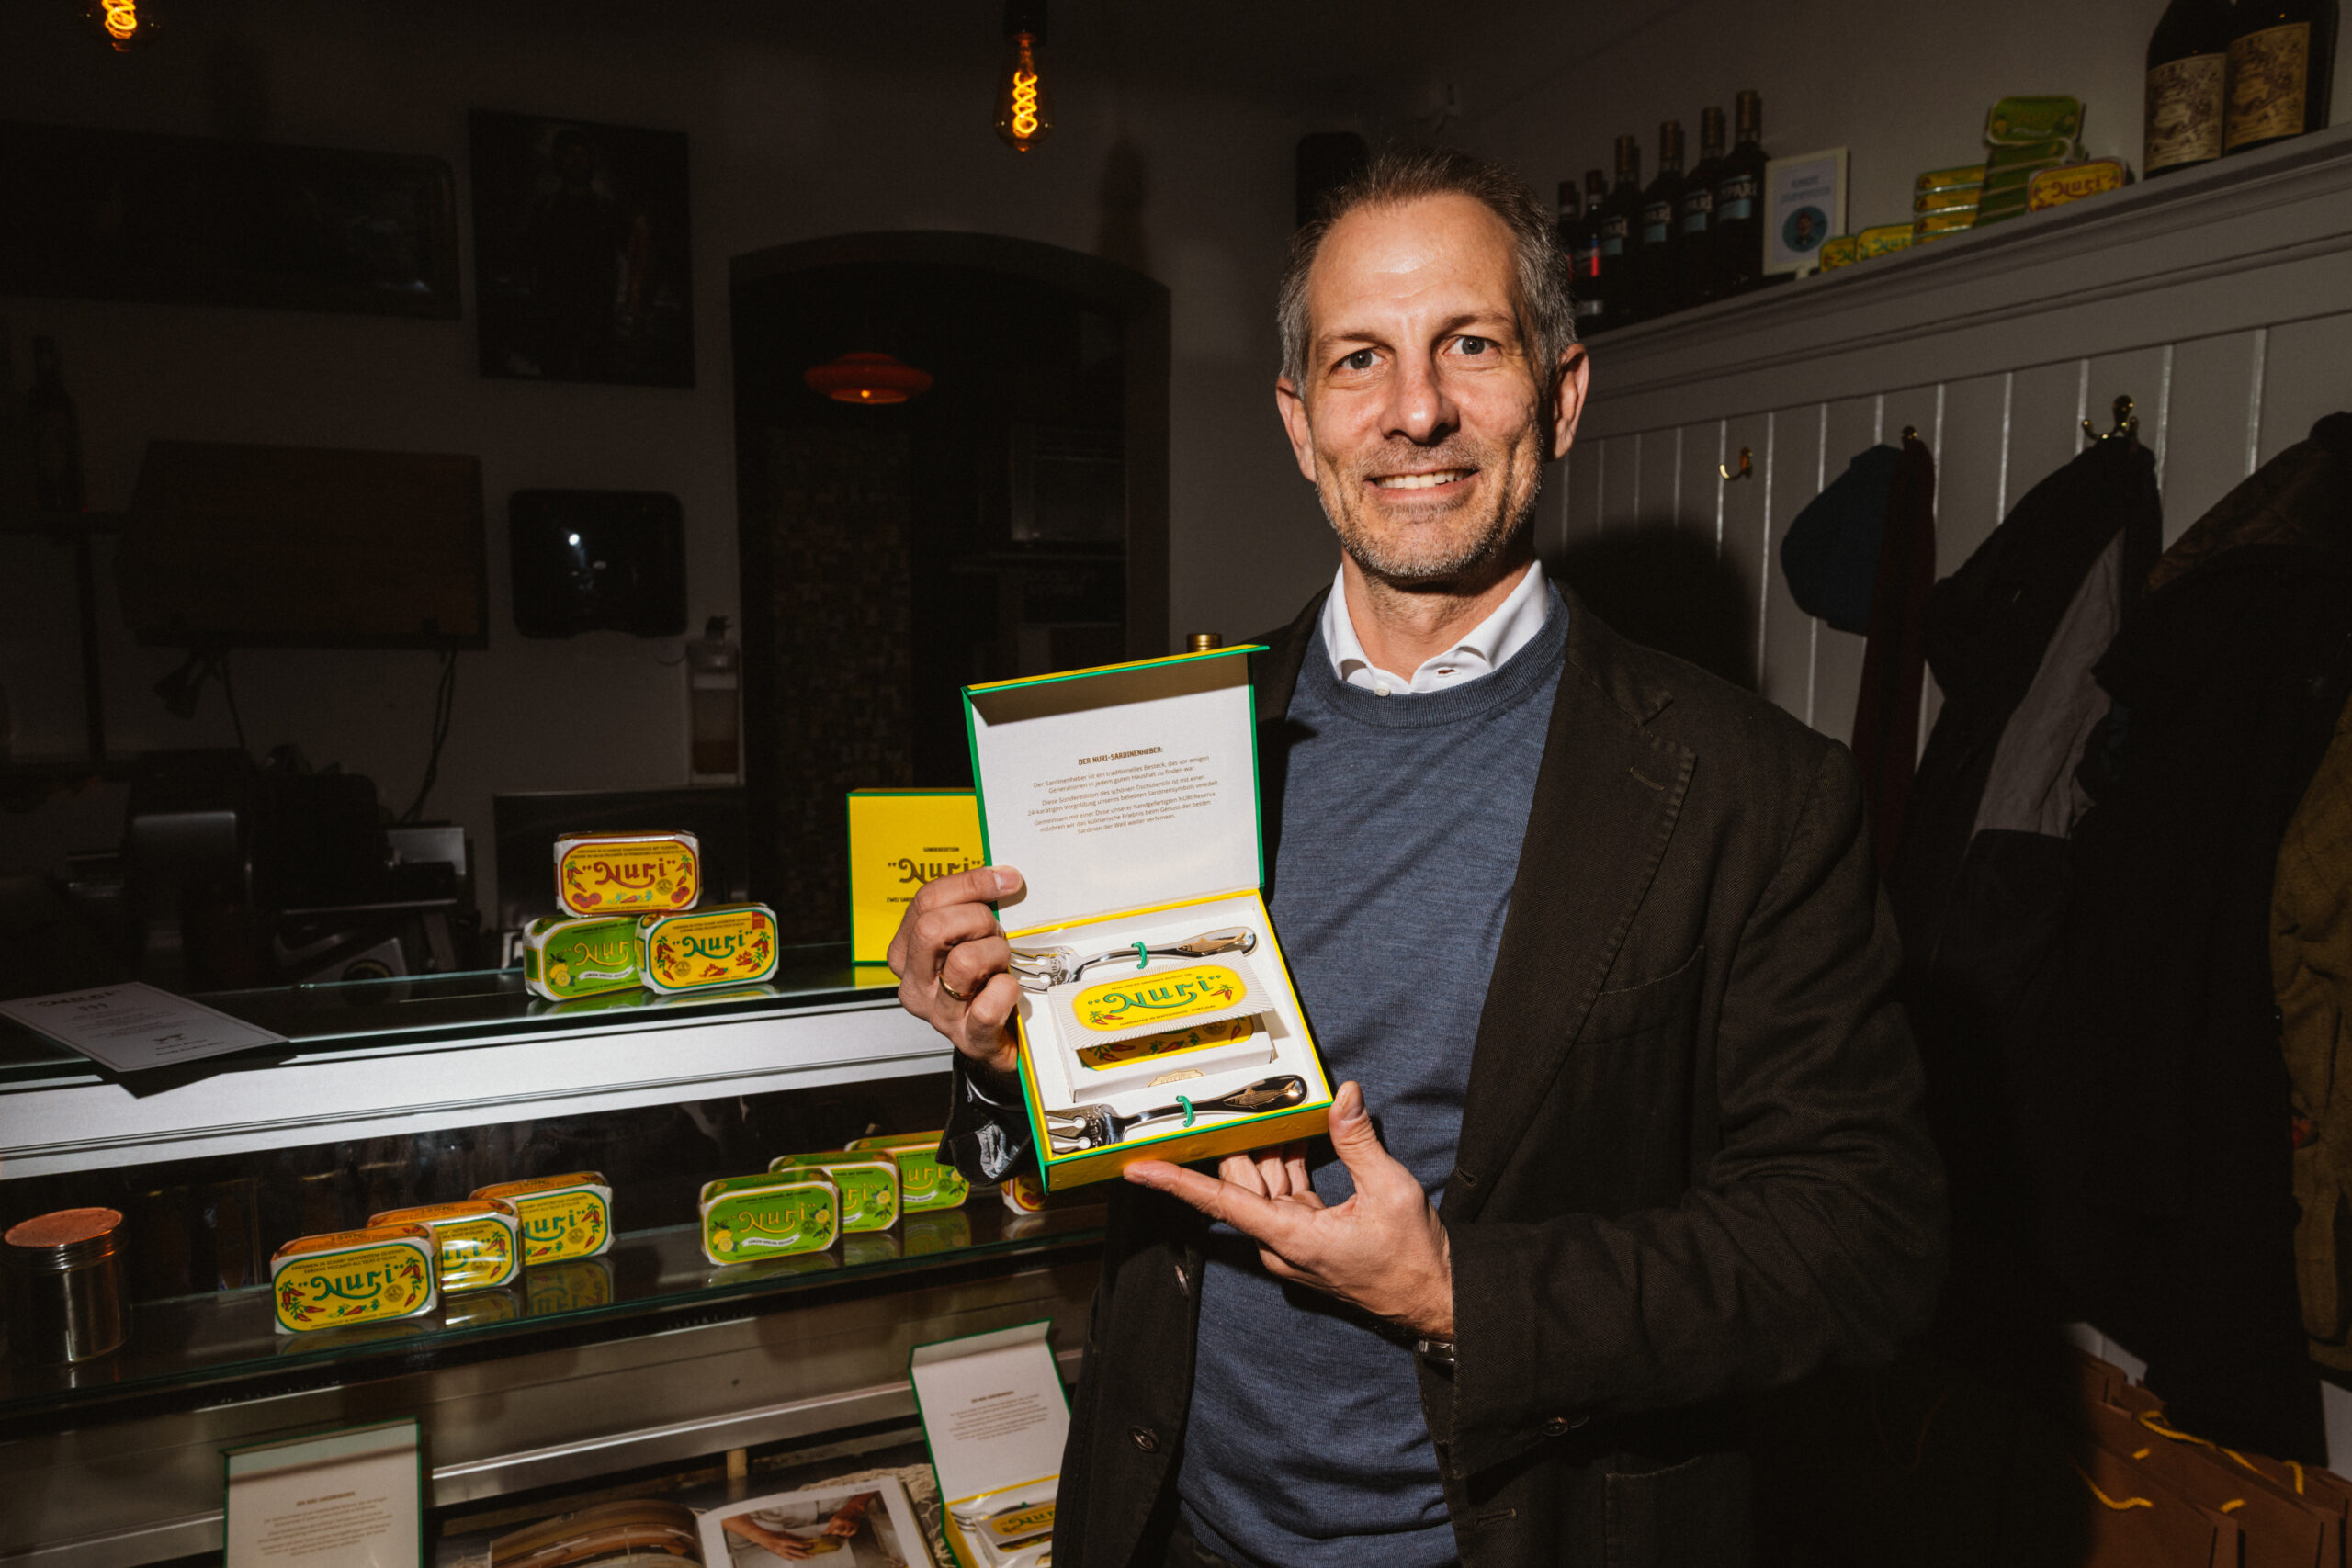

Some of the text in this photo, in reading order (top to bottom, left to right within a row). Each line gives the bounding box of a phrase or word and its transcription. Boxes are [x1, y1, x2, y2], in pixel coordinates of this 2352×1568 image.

[1078, 757, 1091, 766] DER
[1088, 975, 1221, 1014] "Nuri"
[298, 1264, 404, 1301] "Nuri"
